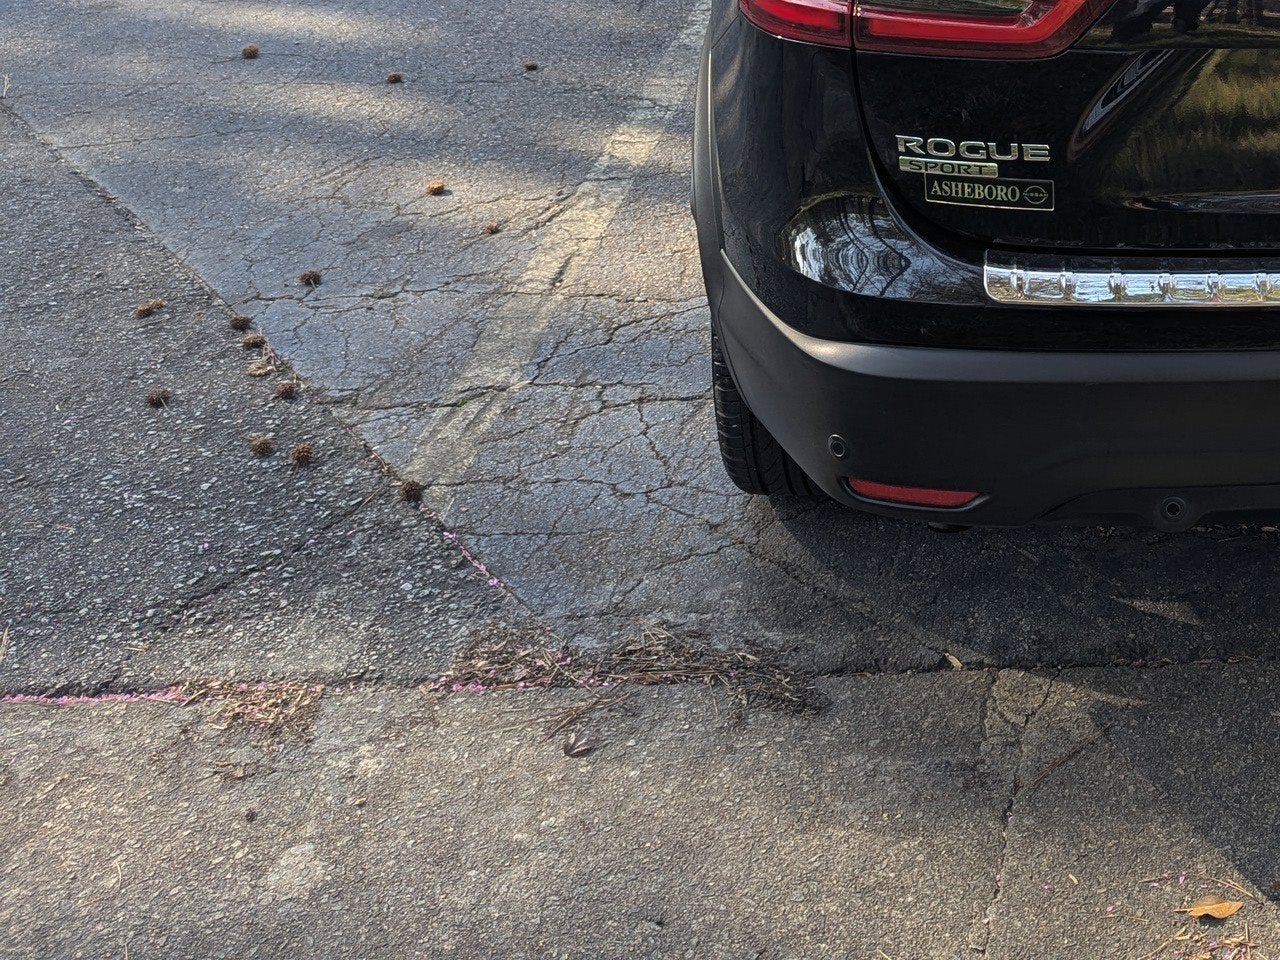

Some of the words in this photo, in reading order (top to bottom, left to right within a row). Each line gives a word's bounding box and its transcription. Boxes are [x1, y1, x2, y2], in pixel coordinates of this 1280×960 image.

[895, 134, 1050, 161] ROGUE
[909, 160, 989, 175] SPORT
[931, 180, 1020, 201] ASHEBORO
